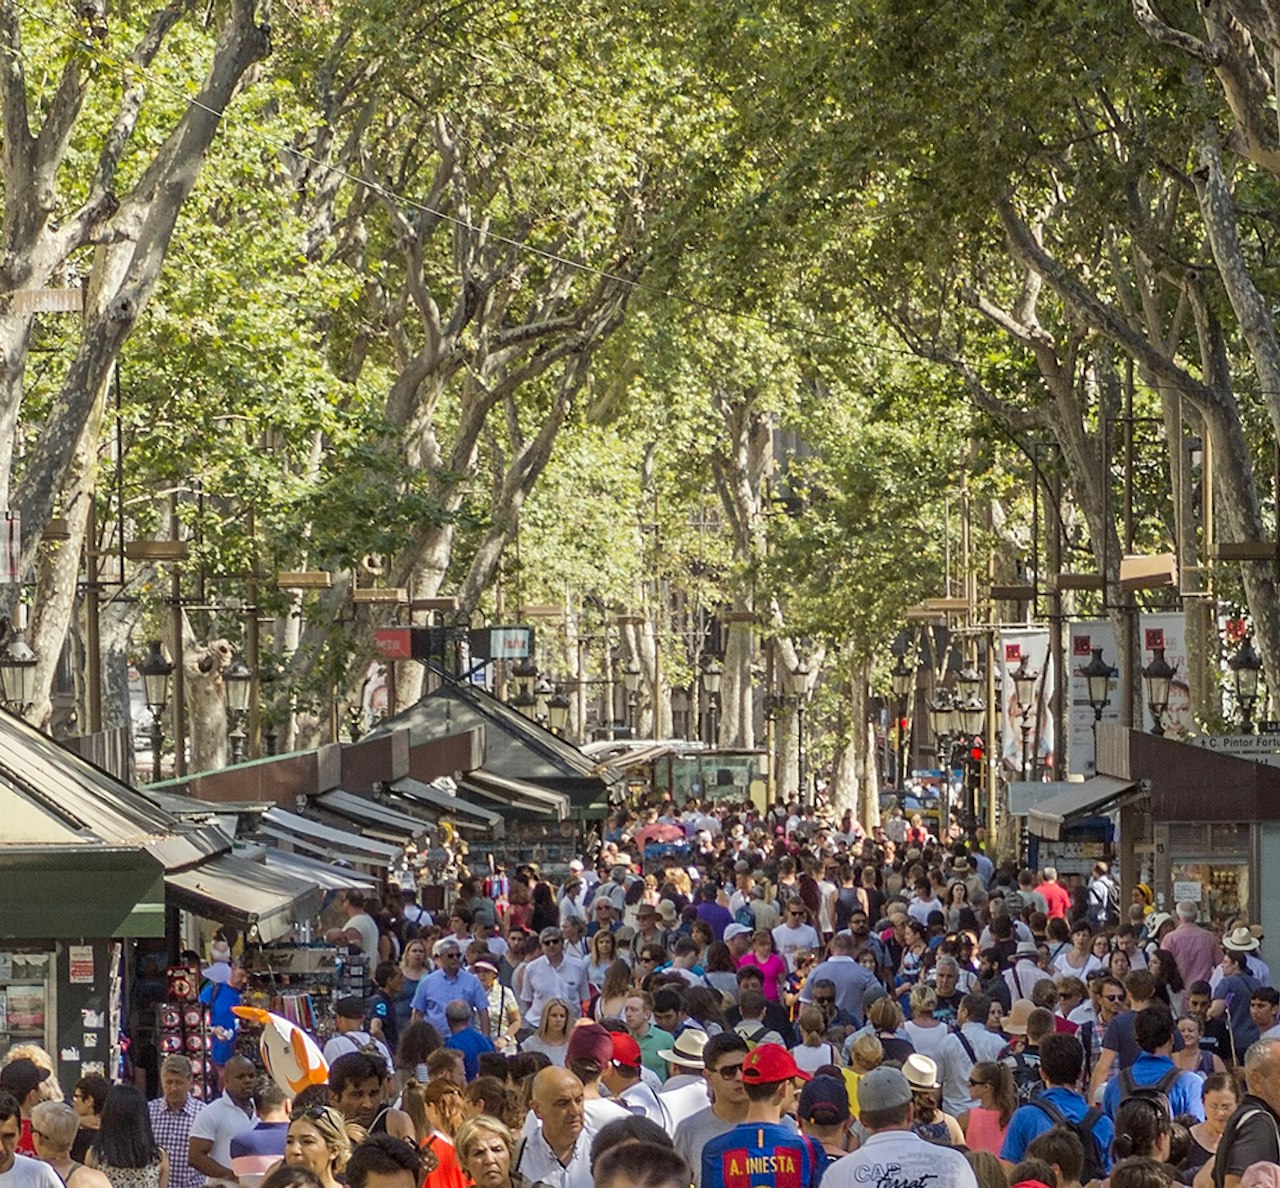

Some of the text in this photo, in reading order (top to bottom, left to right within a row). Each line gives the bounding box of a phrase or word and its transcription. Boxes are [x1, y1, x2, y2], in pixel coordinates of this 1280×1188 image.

[1224, 738, 1253, 747] Pintor
[730, 1156, 795, 1176] A. INIESTA
[854, 1162, 901, 1183] CAP
